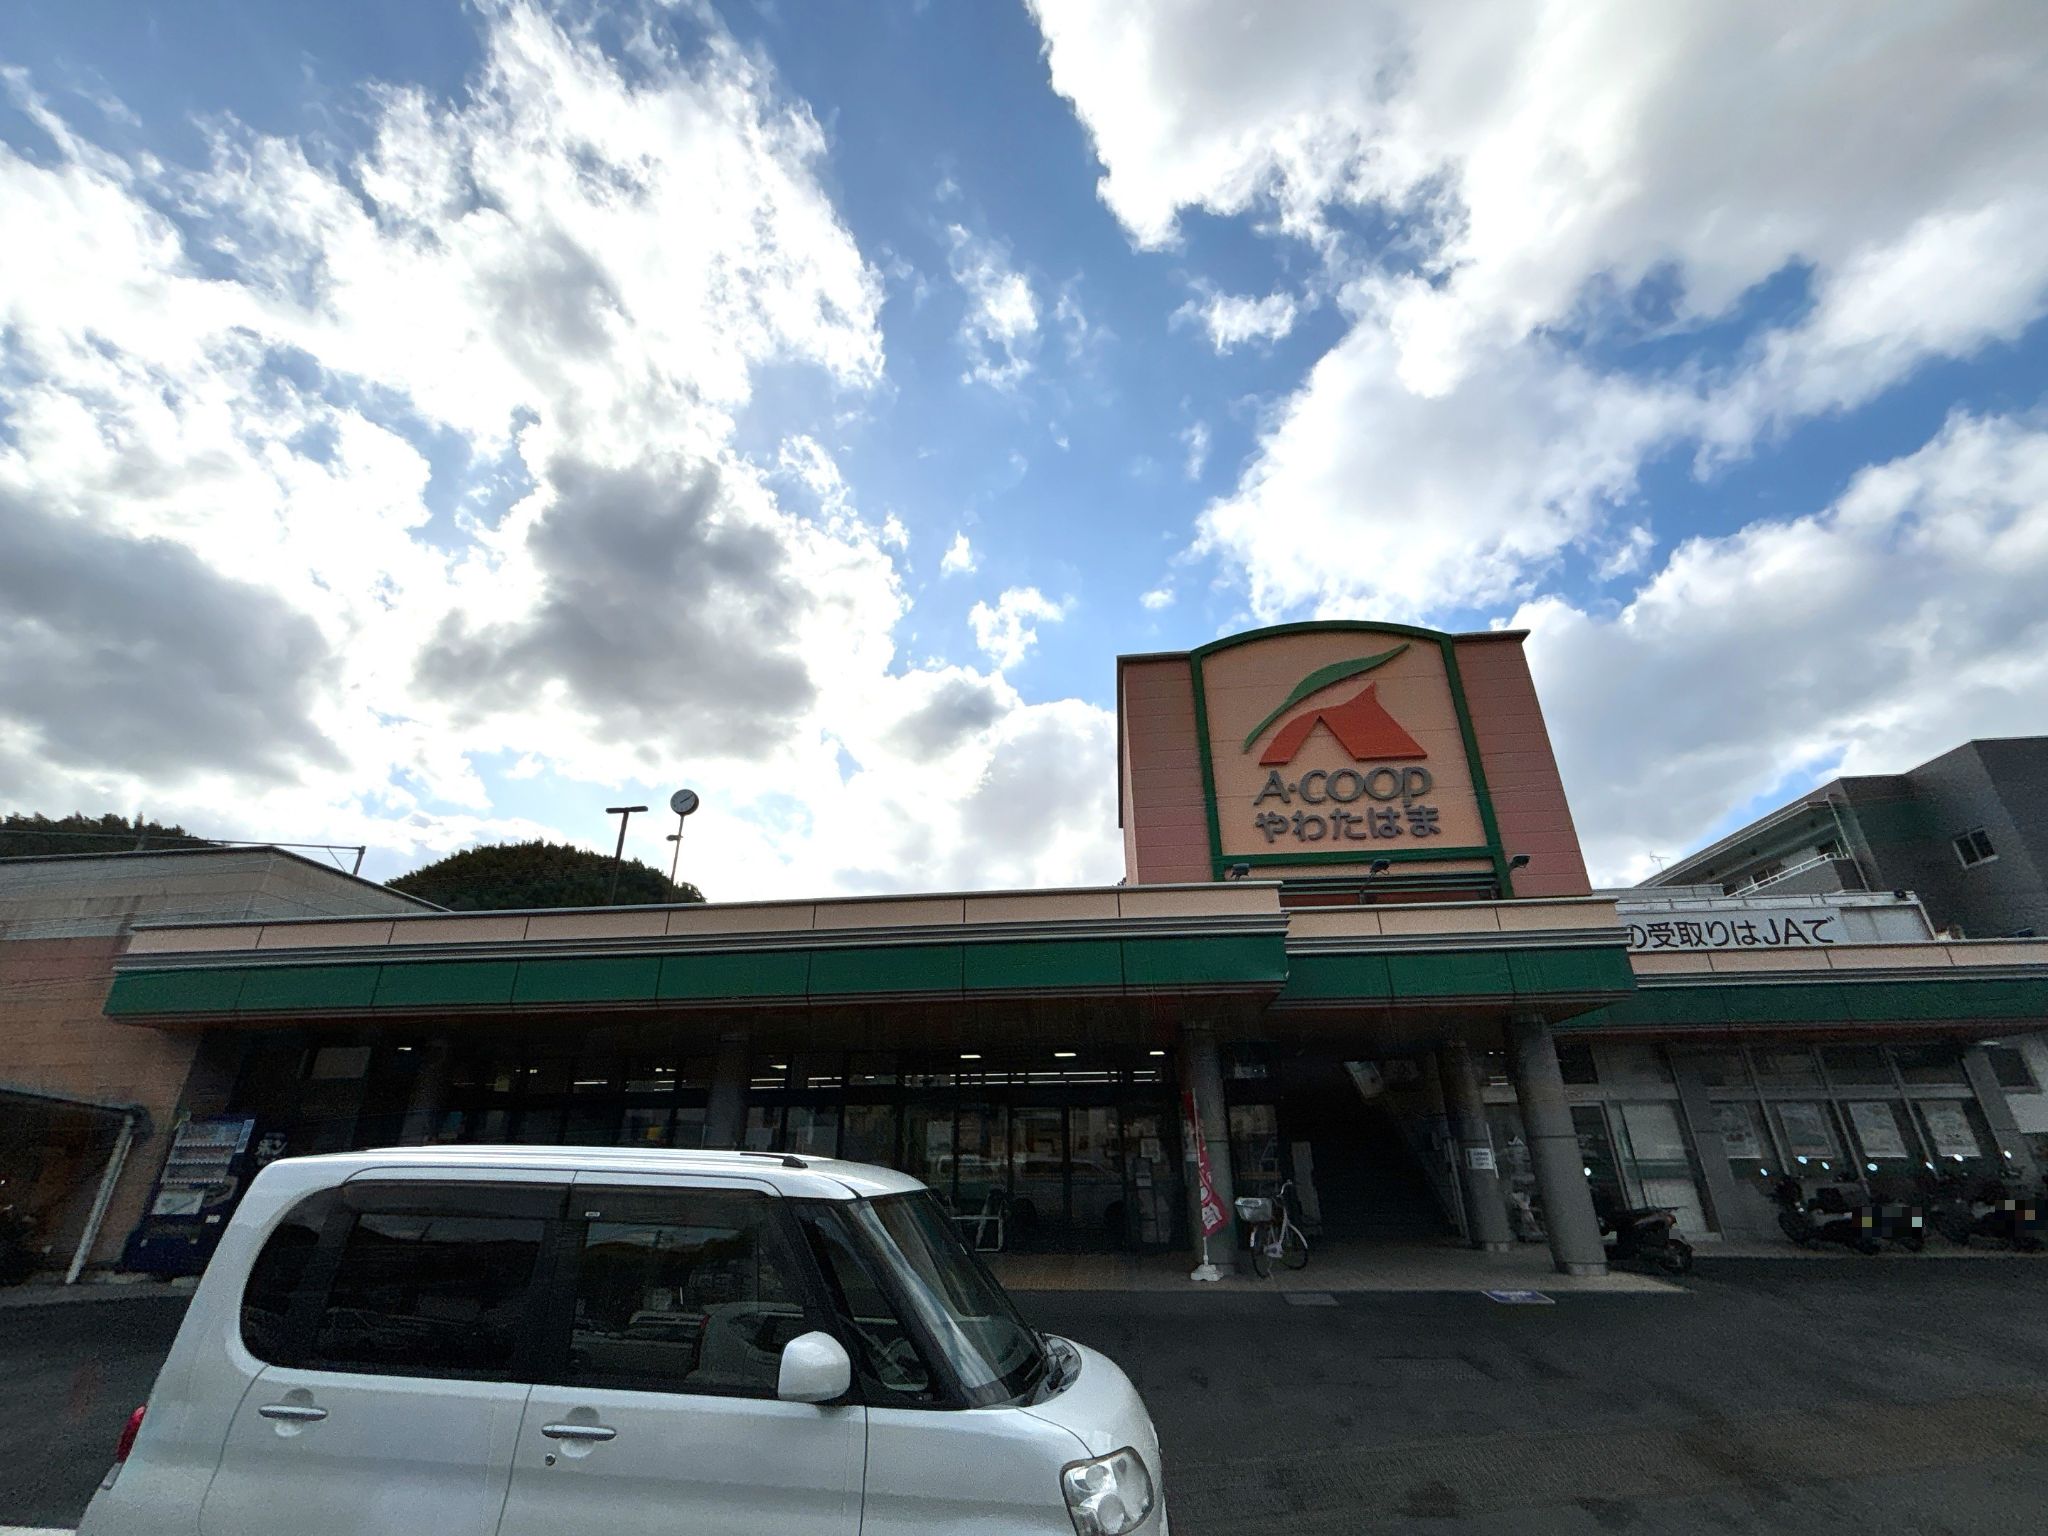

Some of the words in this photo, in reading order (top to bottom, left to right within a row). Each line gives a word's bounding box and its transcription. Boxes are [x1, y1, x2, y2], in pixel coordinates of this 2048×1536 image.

[1255, 805, 1441, 843] やわたはま
